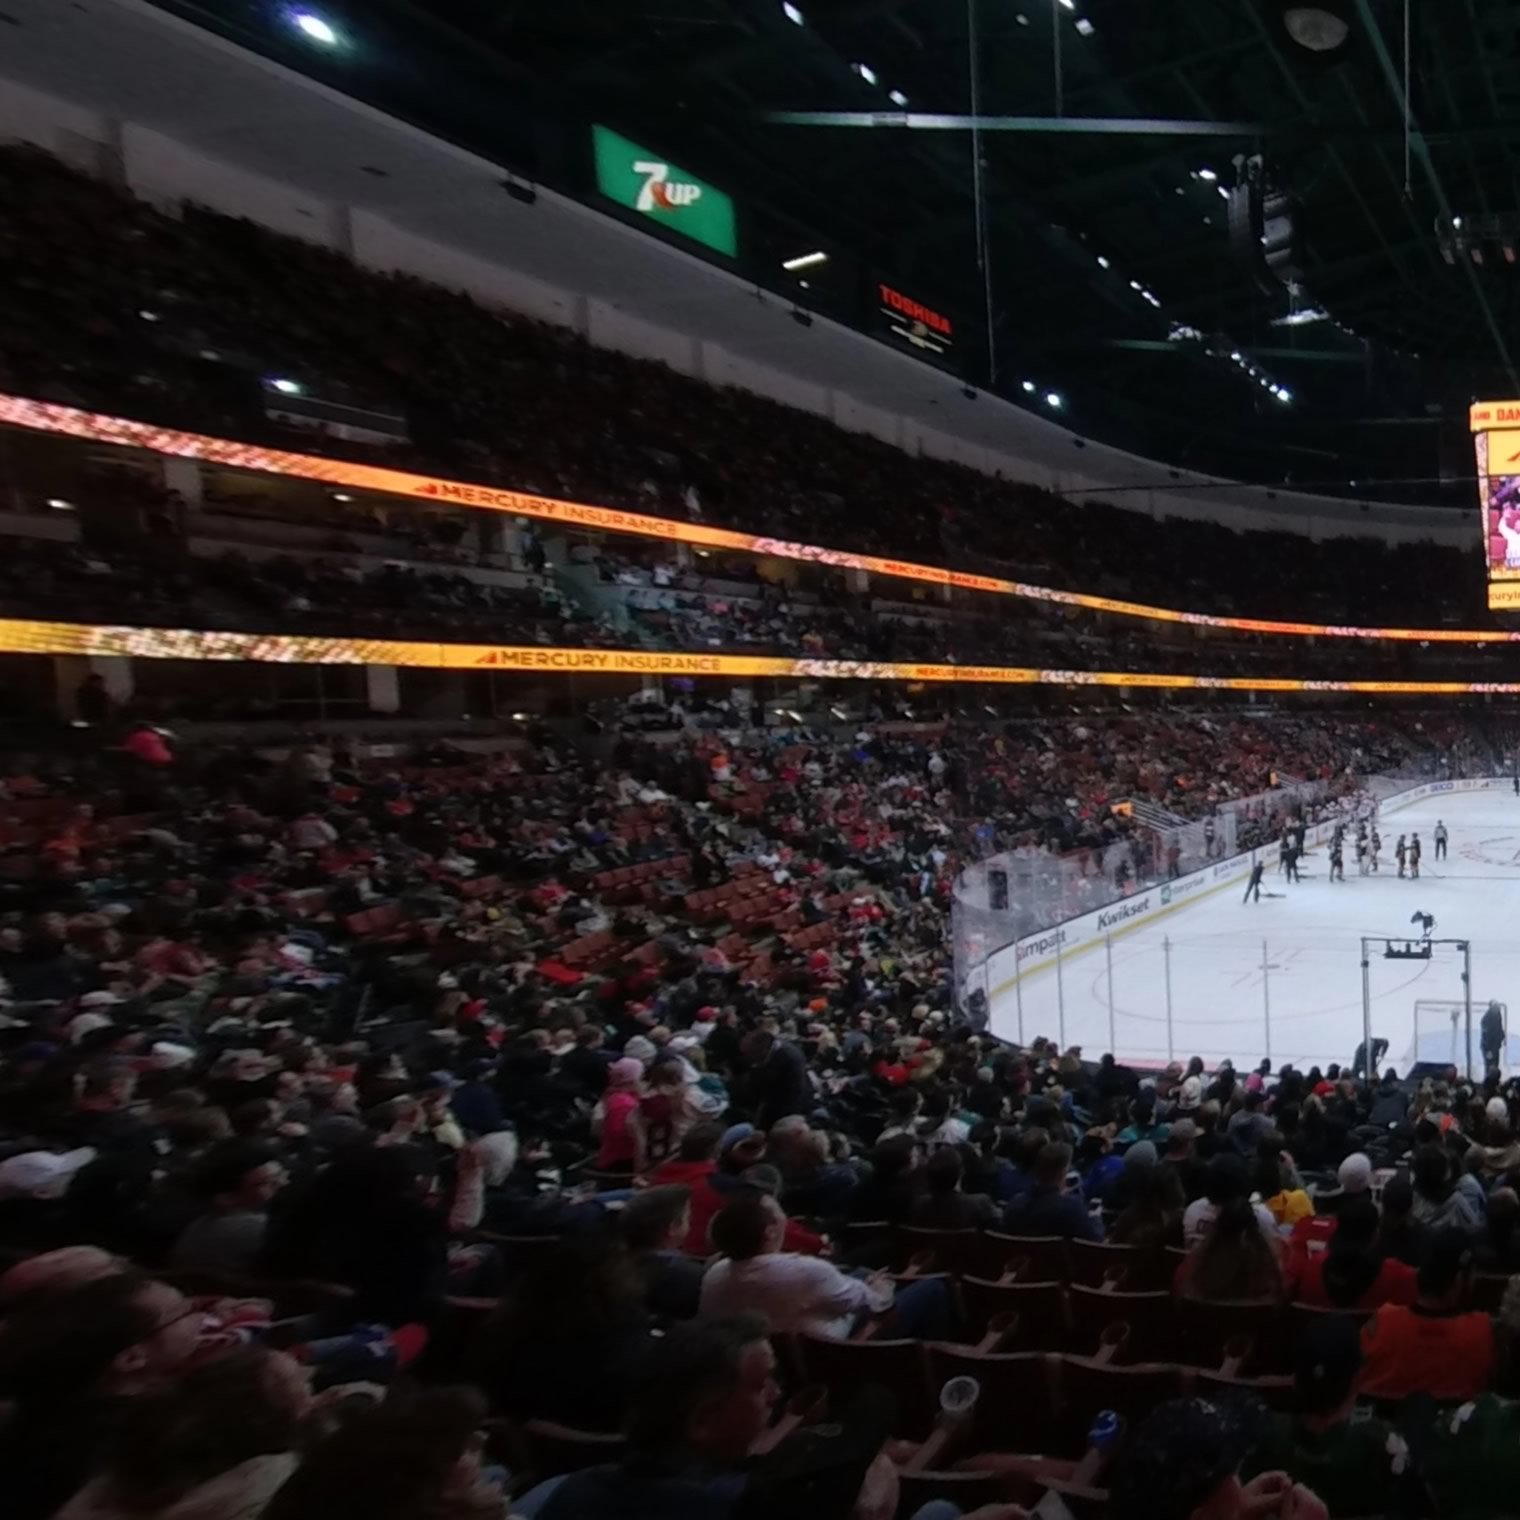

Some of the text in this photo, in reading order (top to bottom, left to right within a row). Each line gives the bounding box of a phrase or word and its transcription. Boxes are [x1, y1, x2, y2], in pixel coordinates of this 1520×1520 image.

[880, 284, 952, 335] TOSHIBA
[440, 484, 676, 537] MERCURY INSURANCE
[501, 650, 721, 672] MERCURY INSURANCE
[1097, 898, 1150, 931] Kwikset
